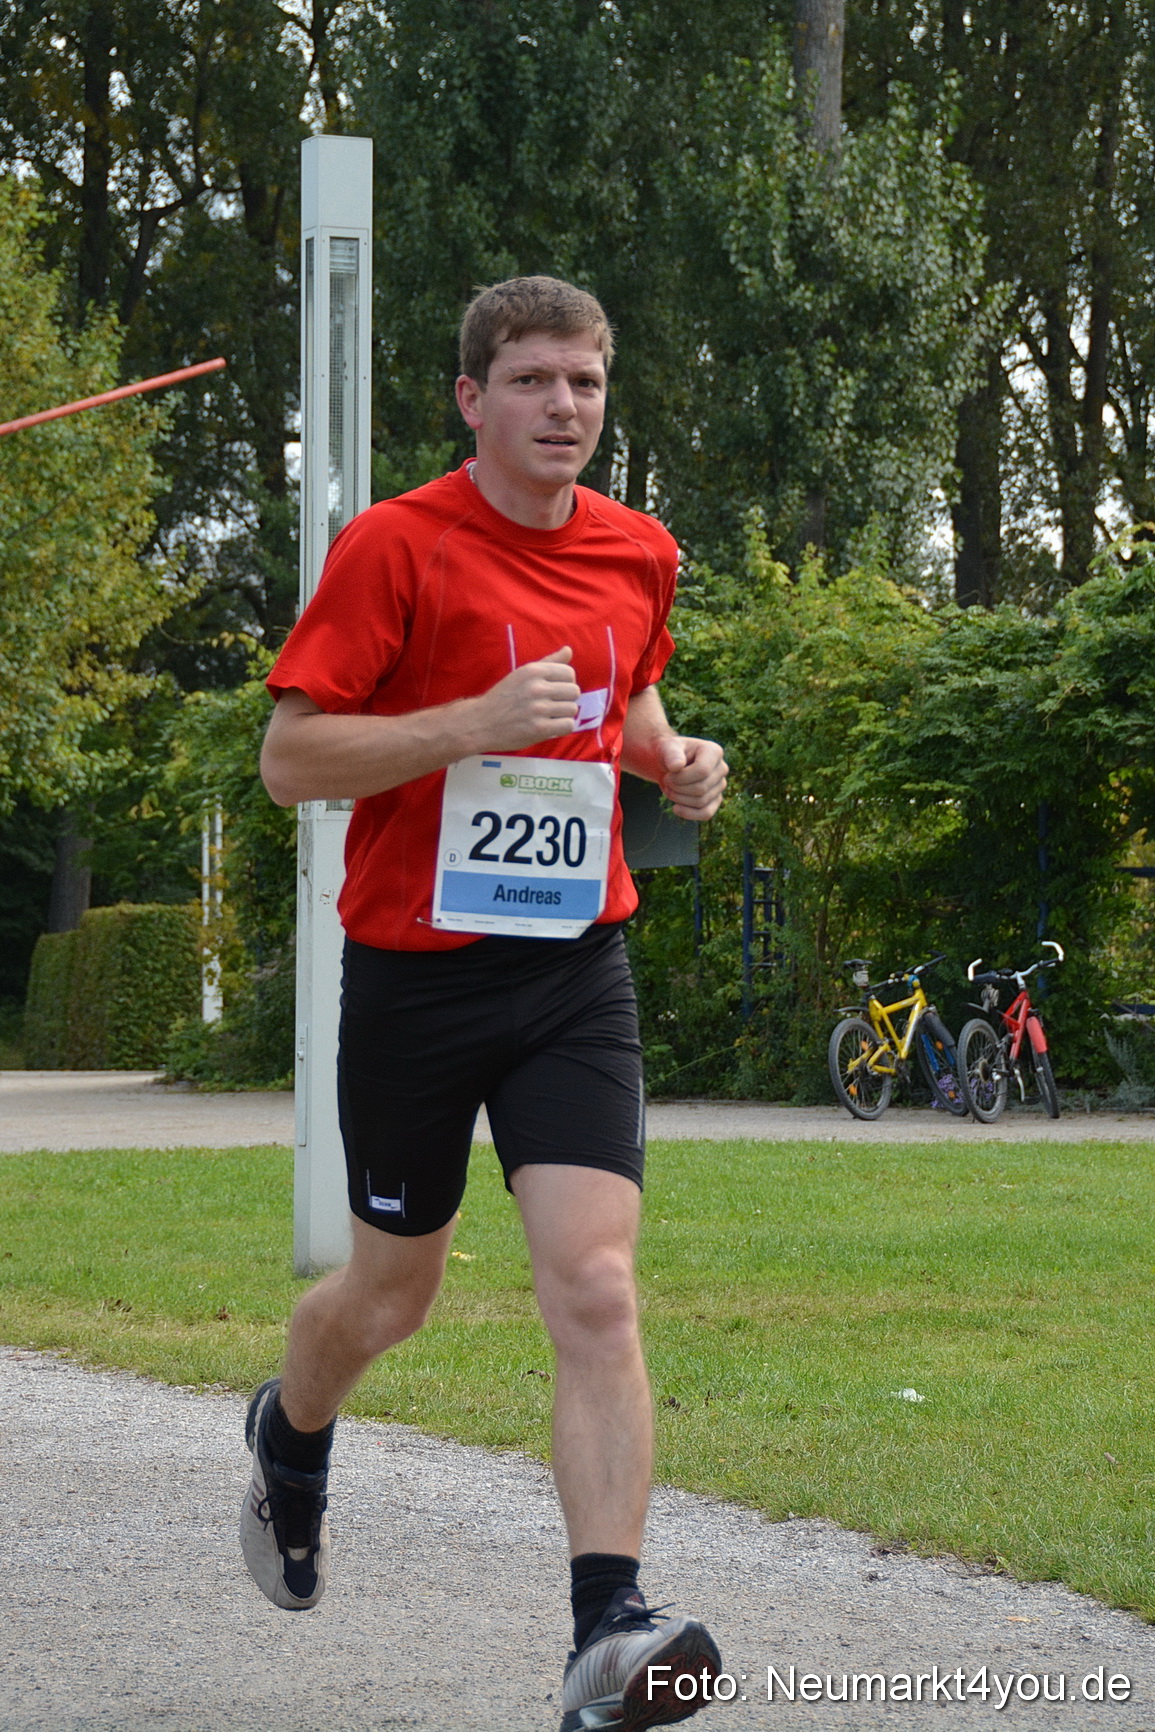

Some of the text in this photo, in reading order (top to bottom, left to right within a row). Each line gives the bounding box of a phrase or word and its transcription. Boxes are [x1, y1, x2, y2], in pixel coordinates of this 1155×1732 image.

[518, 775, 573, 792] BOCK
[468, 810, 587, 868] 2230
[449, 853, 456, 863] D
[493, 884, 562, 905] Andreas
